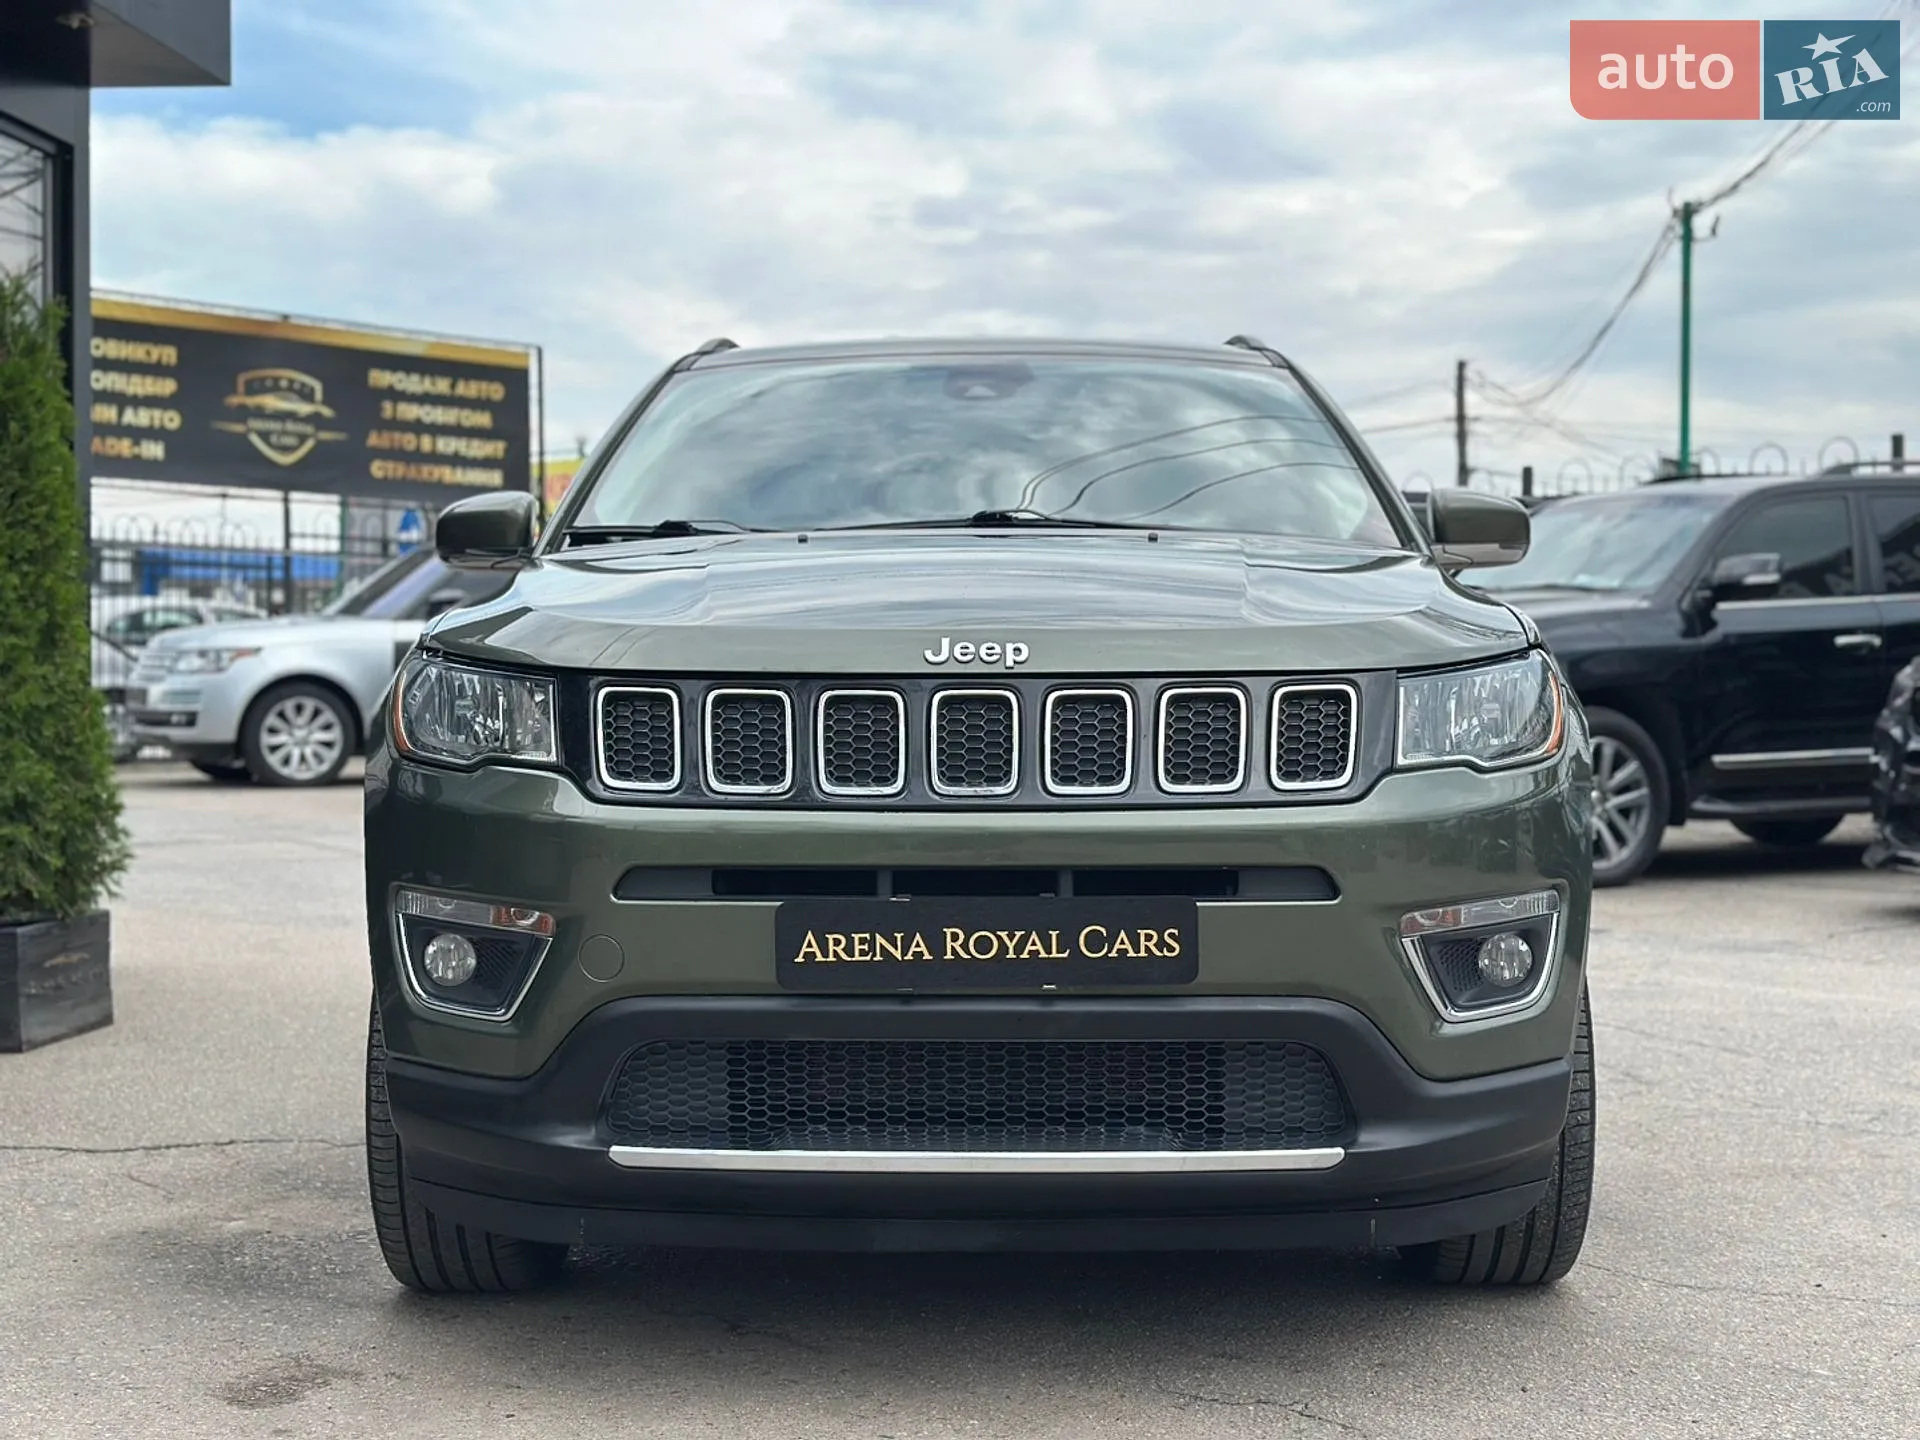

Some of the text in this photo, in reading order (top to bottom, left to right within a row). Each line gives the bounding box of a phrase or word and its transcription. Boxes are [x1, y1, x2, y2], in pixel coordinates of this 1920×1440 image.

[367, 367, 506, 402] ПРОДАЖ АВТО
[121, 404, 182, 431] АВТО
[396, 401, 494, 430] ПРОБІГОМ
[366, 429, 419, 453] АВТО
[435, 434, 508, 460] КРЕДИТ
[369, 458, 504, 488] СТРАХУВАННЯ
[923, 636, 1030, 669] Jeep
[794, 925, 1181, 963] ARENA ROYAL CARS
